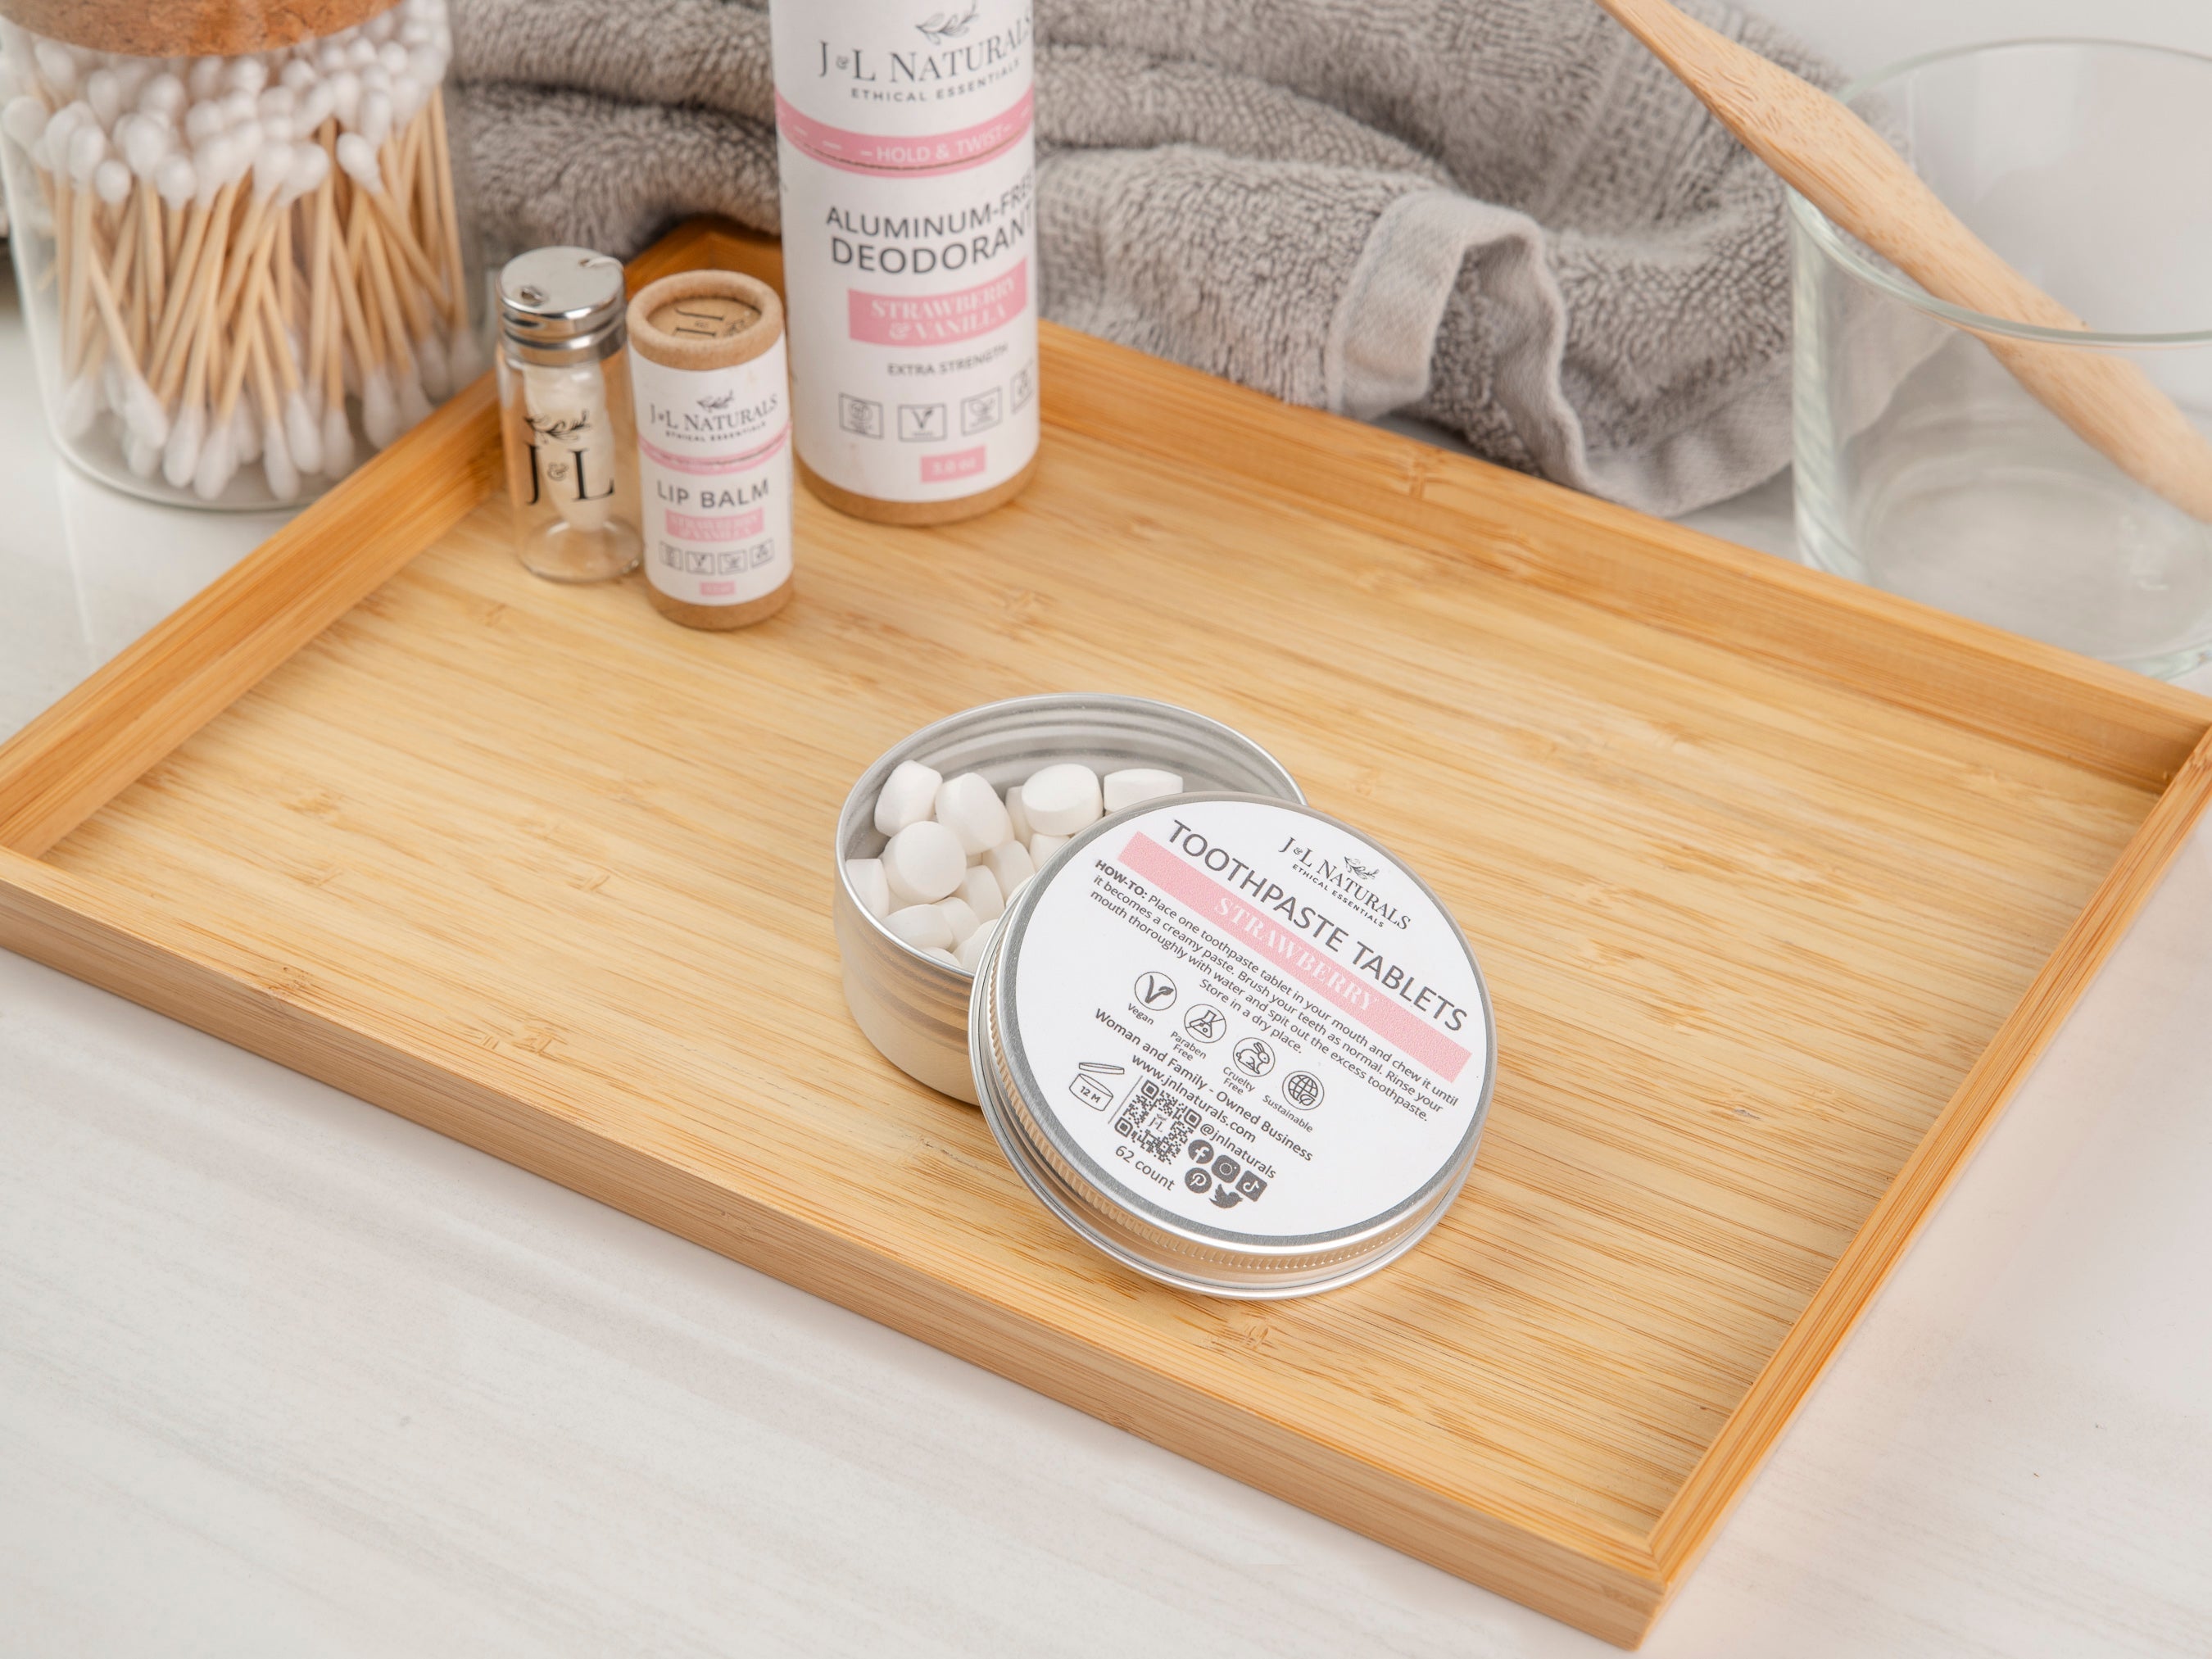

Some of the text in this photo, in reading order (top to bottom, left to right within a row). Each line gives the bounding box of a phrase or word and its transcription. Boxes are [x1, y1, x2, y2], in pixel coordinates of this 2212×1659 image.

[851, 59, 1019, 102] ETHICAL ESSENTIALS
[877, 125, 1004, 163] HOLD & TWIST
[871, 277, 1016, 320] STRAWBERRY
[887, 342, 1009, 376] EXTRA STRENGTH
[684, 393, 777, 433] NATURALS
[657, 478, 768, 509] LIP BALM
[1291, 863, 1385, 927] ETHICAL ESSENTIALS
[1315, 858, 1412, 930] NATURALS
[1168, 818, 1468, 1031] TOOTHPASTE TABLETS
[1213, 895, 1375, 1011] STRAWBERRY
[1092, 873, 1444, 1113] it becomes a creamy paste. Brush your teeth as normal. Rinse your
[1094, 859, 1459, 1107] HOW-TO: Place one toothpaste tablet in your mouth and chew it until
[1089, 890, 1427, 1122] mouth thoroughly with water and spit out the excess toothpaste.
[1126, 1001, 1154, 1026] Vegan
[1198, 977, 1302, 1054] Store in a dry place.
[1169, 1030, 1207, 1059] Paraben
[1172, 1042, 1194, 1062] Free
[1094, 1007, 1141, 1046] Woman
[1141, 1041, 1169, 1063] and
[1166, 1056, 1208, 1090] Family
[1215, 1090, 1262, 1126] Owned
[1259, 1119, 1313, 1162] Business
[1131, 1054, 1257, 1144] www.jnlnaturals.com
[1222, 1066, 1256, 1093] Cruelty
[1222, 1077, 1246, 1095] Free
[1261, 1094, 1313, 1133] Sustainable
[1114, 1145, 1176, 1191] 62 count
[1199, 1122, 1276, 1179] @jnlnaturals
